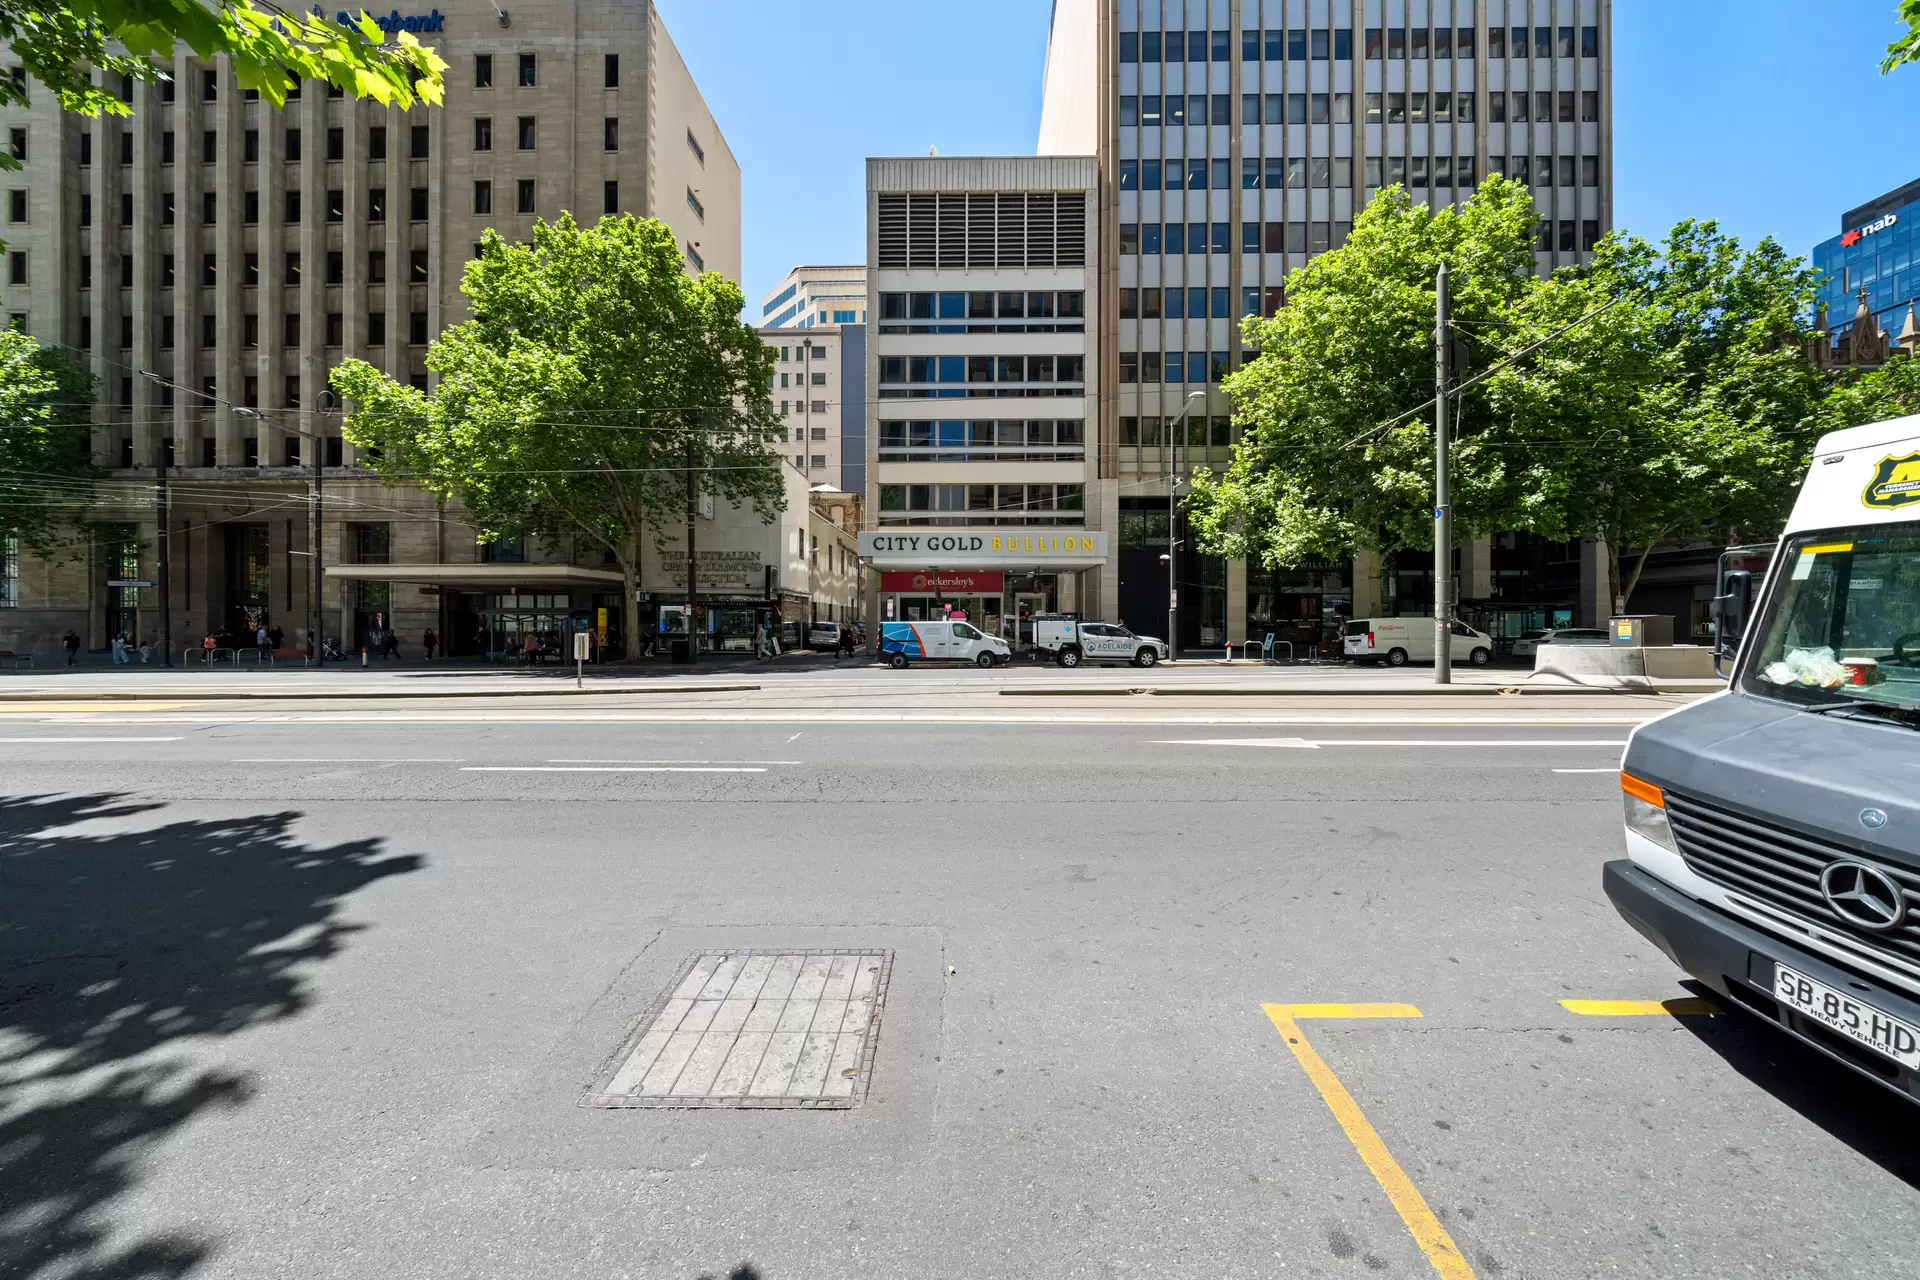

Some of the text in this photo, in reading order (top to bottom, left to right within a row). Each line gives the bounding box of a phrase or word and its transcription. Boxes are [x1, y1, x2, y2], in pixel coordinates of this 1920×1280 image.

[336, 9, 445, 33] Robank
[1862, 214, 1897, 237] nab
[873, 537, 1093, 551] CITY GOLD BULLION
[662, 551, 685, 560] THE
[704, 562, 763, 572] DIAMOND
[673, 573, 747, 583] COLECTION
[927, 577, 974, 588] eckersley's
[1789, 997, 1802, 1008] SA
[1810, 1008, 1845, 1030] HEAVY
[1849, 1028, 1900, 1058] VEHICLE
